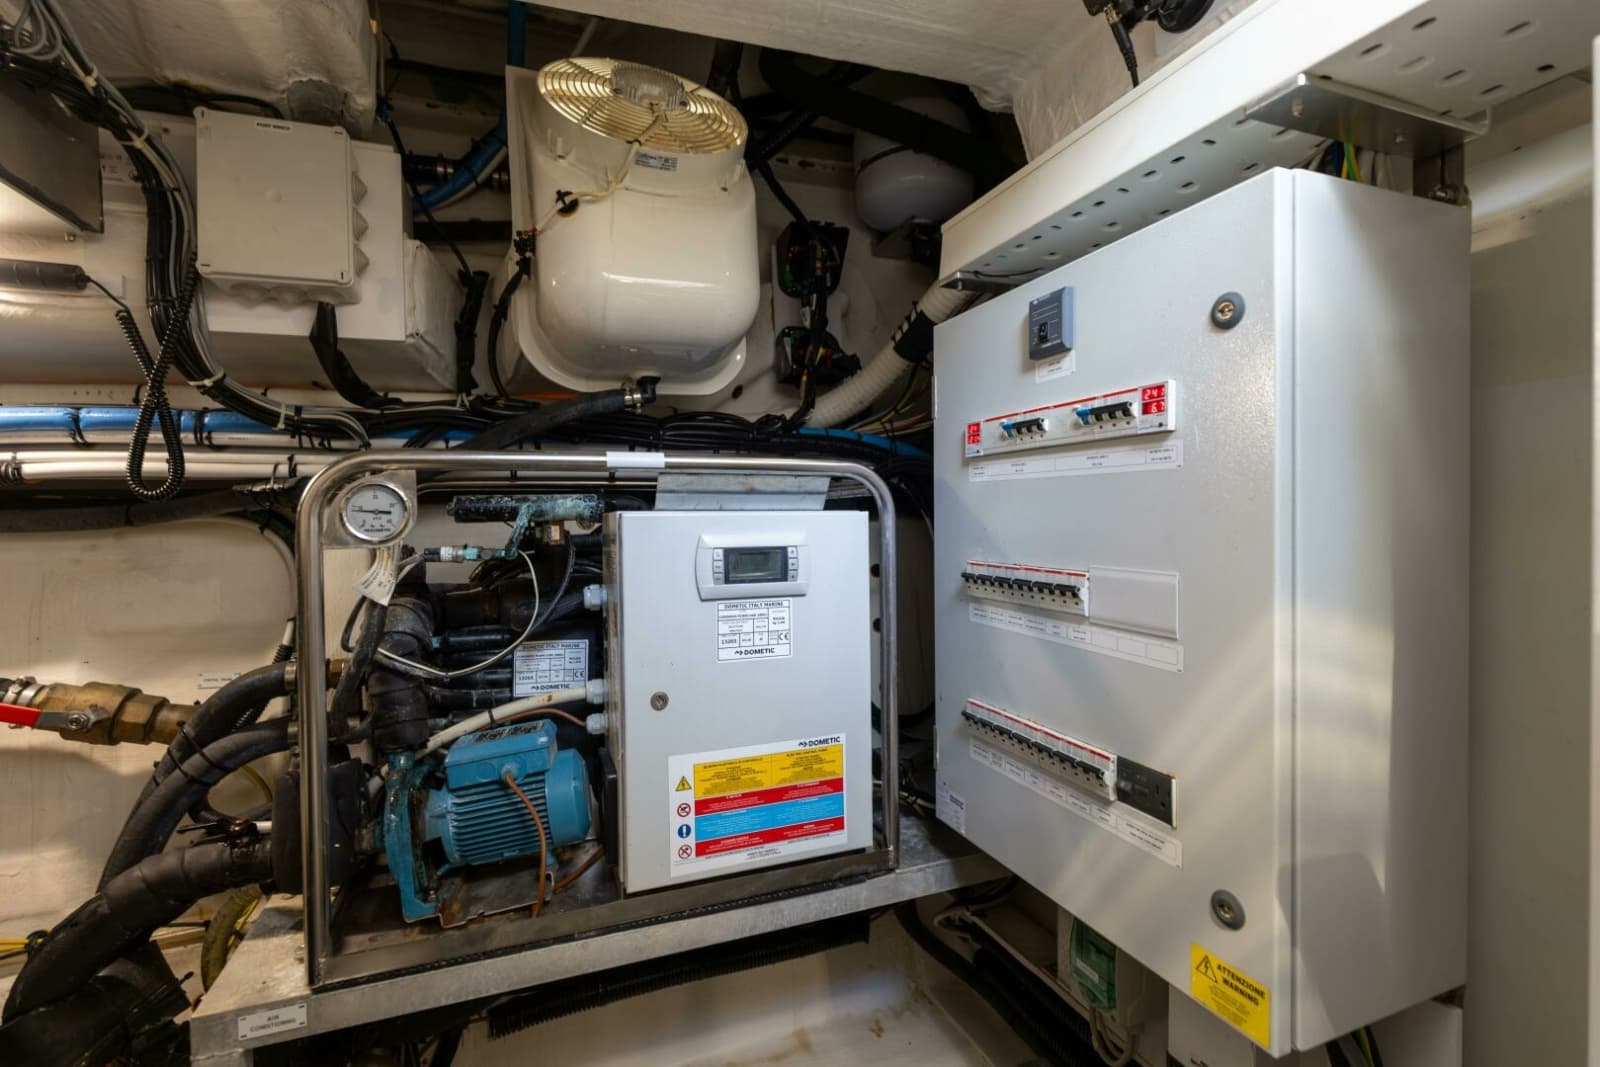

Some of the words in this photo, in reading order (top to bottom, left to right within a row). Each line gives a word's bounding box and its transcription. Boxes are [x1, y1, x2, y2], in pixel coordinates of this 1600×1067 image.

[744, 647, 775, 656] DOMETIC
[540, 683, 570, 691] DOMETIC
[808, 736, 841, 747] DOMETIC
[1216, 963, 1266, 1000] ATTENZIONE
[1222, 976, 1259, 1007] WARNING
